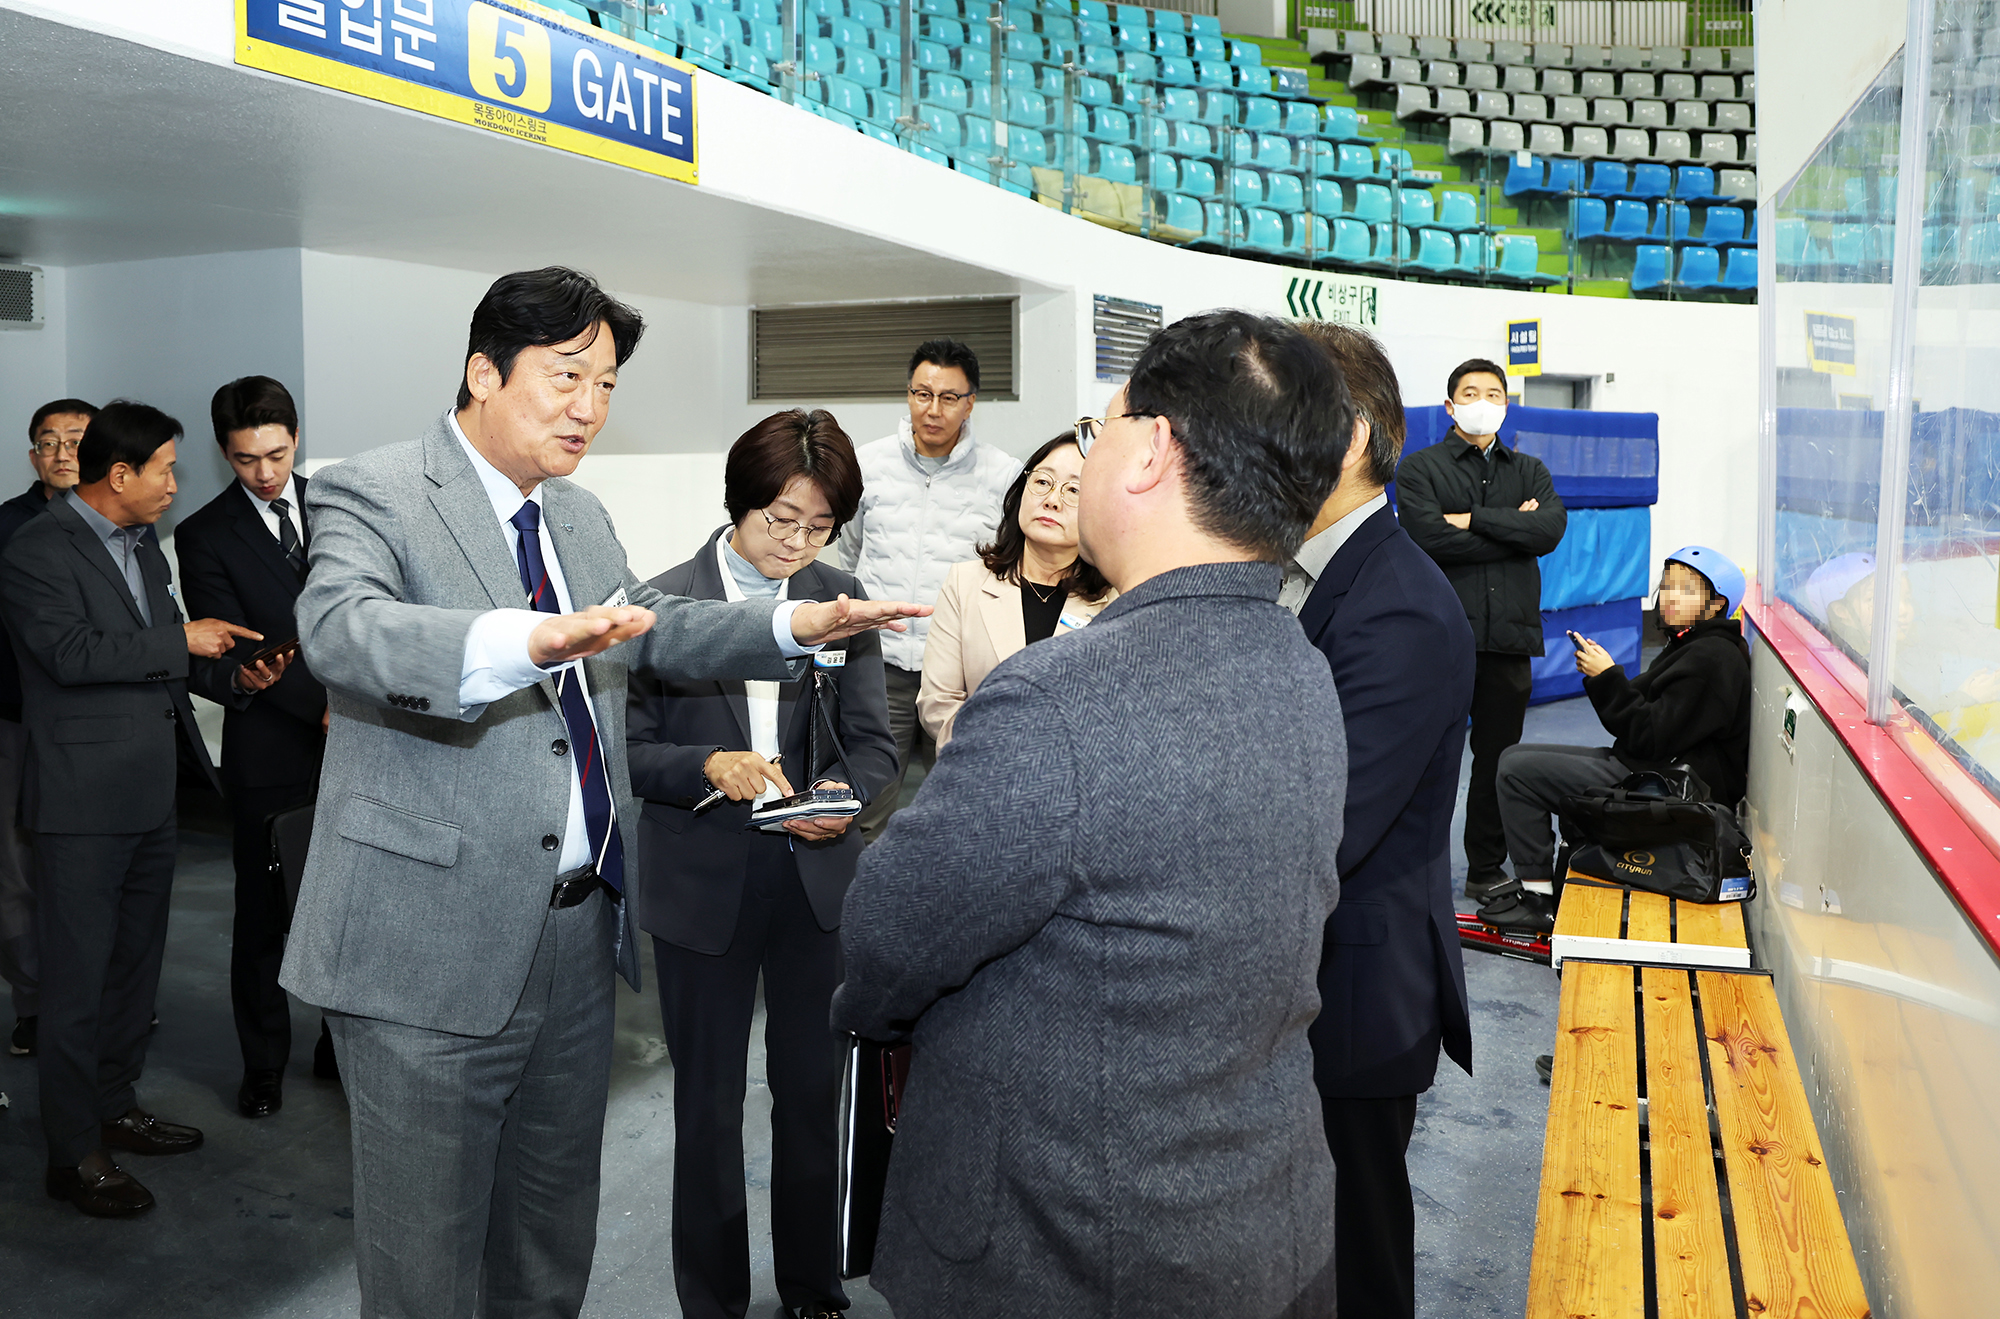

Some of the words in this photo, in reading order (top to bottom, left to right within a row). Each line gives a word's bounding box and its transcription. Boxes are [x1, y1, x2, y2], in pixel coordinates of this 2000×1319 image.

[494, 16, 527, 99] 5
[572, 48, 684, 145] GATE
[474, 102, 547, 134] 목동아이스링크
[474, 118, 515, 134] MOKDONG
[516, 129, 547, 143] ICERINK
[1328, 284, 1357, 306] 비상구
[1333, 309, 1350, 323] EXIT
